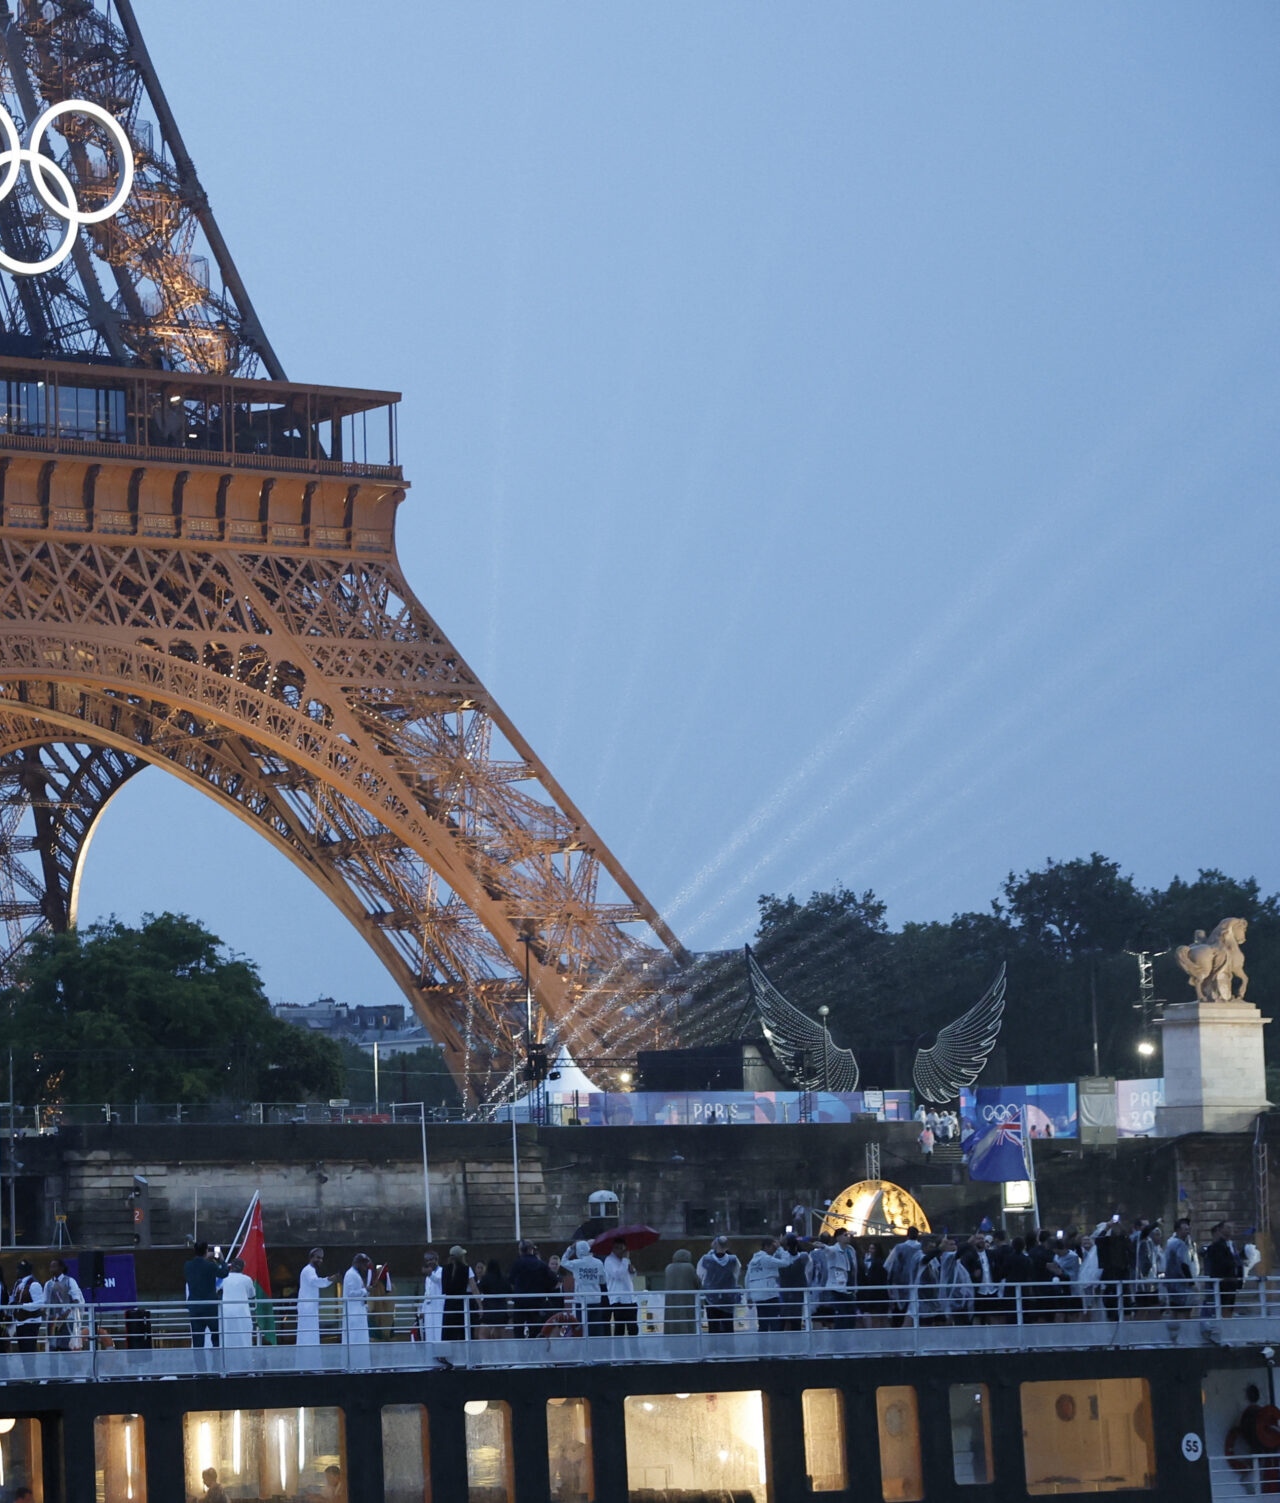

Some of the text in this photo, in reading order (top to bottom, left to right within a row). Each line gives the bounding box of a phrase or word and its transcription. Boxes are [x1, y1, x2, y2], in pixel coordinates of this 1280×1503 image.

[1130, 1090, 1163, 1107] PAR
[693, 1103, 738, 1119] PARIS
[1130, 1110, 1155, 1128] 20
[1185, 1439, 1199, 1453] 55
